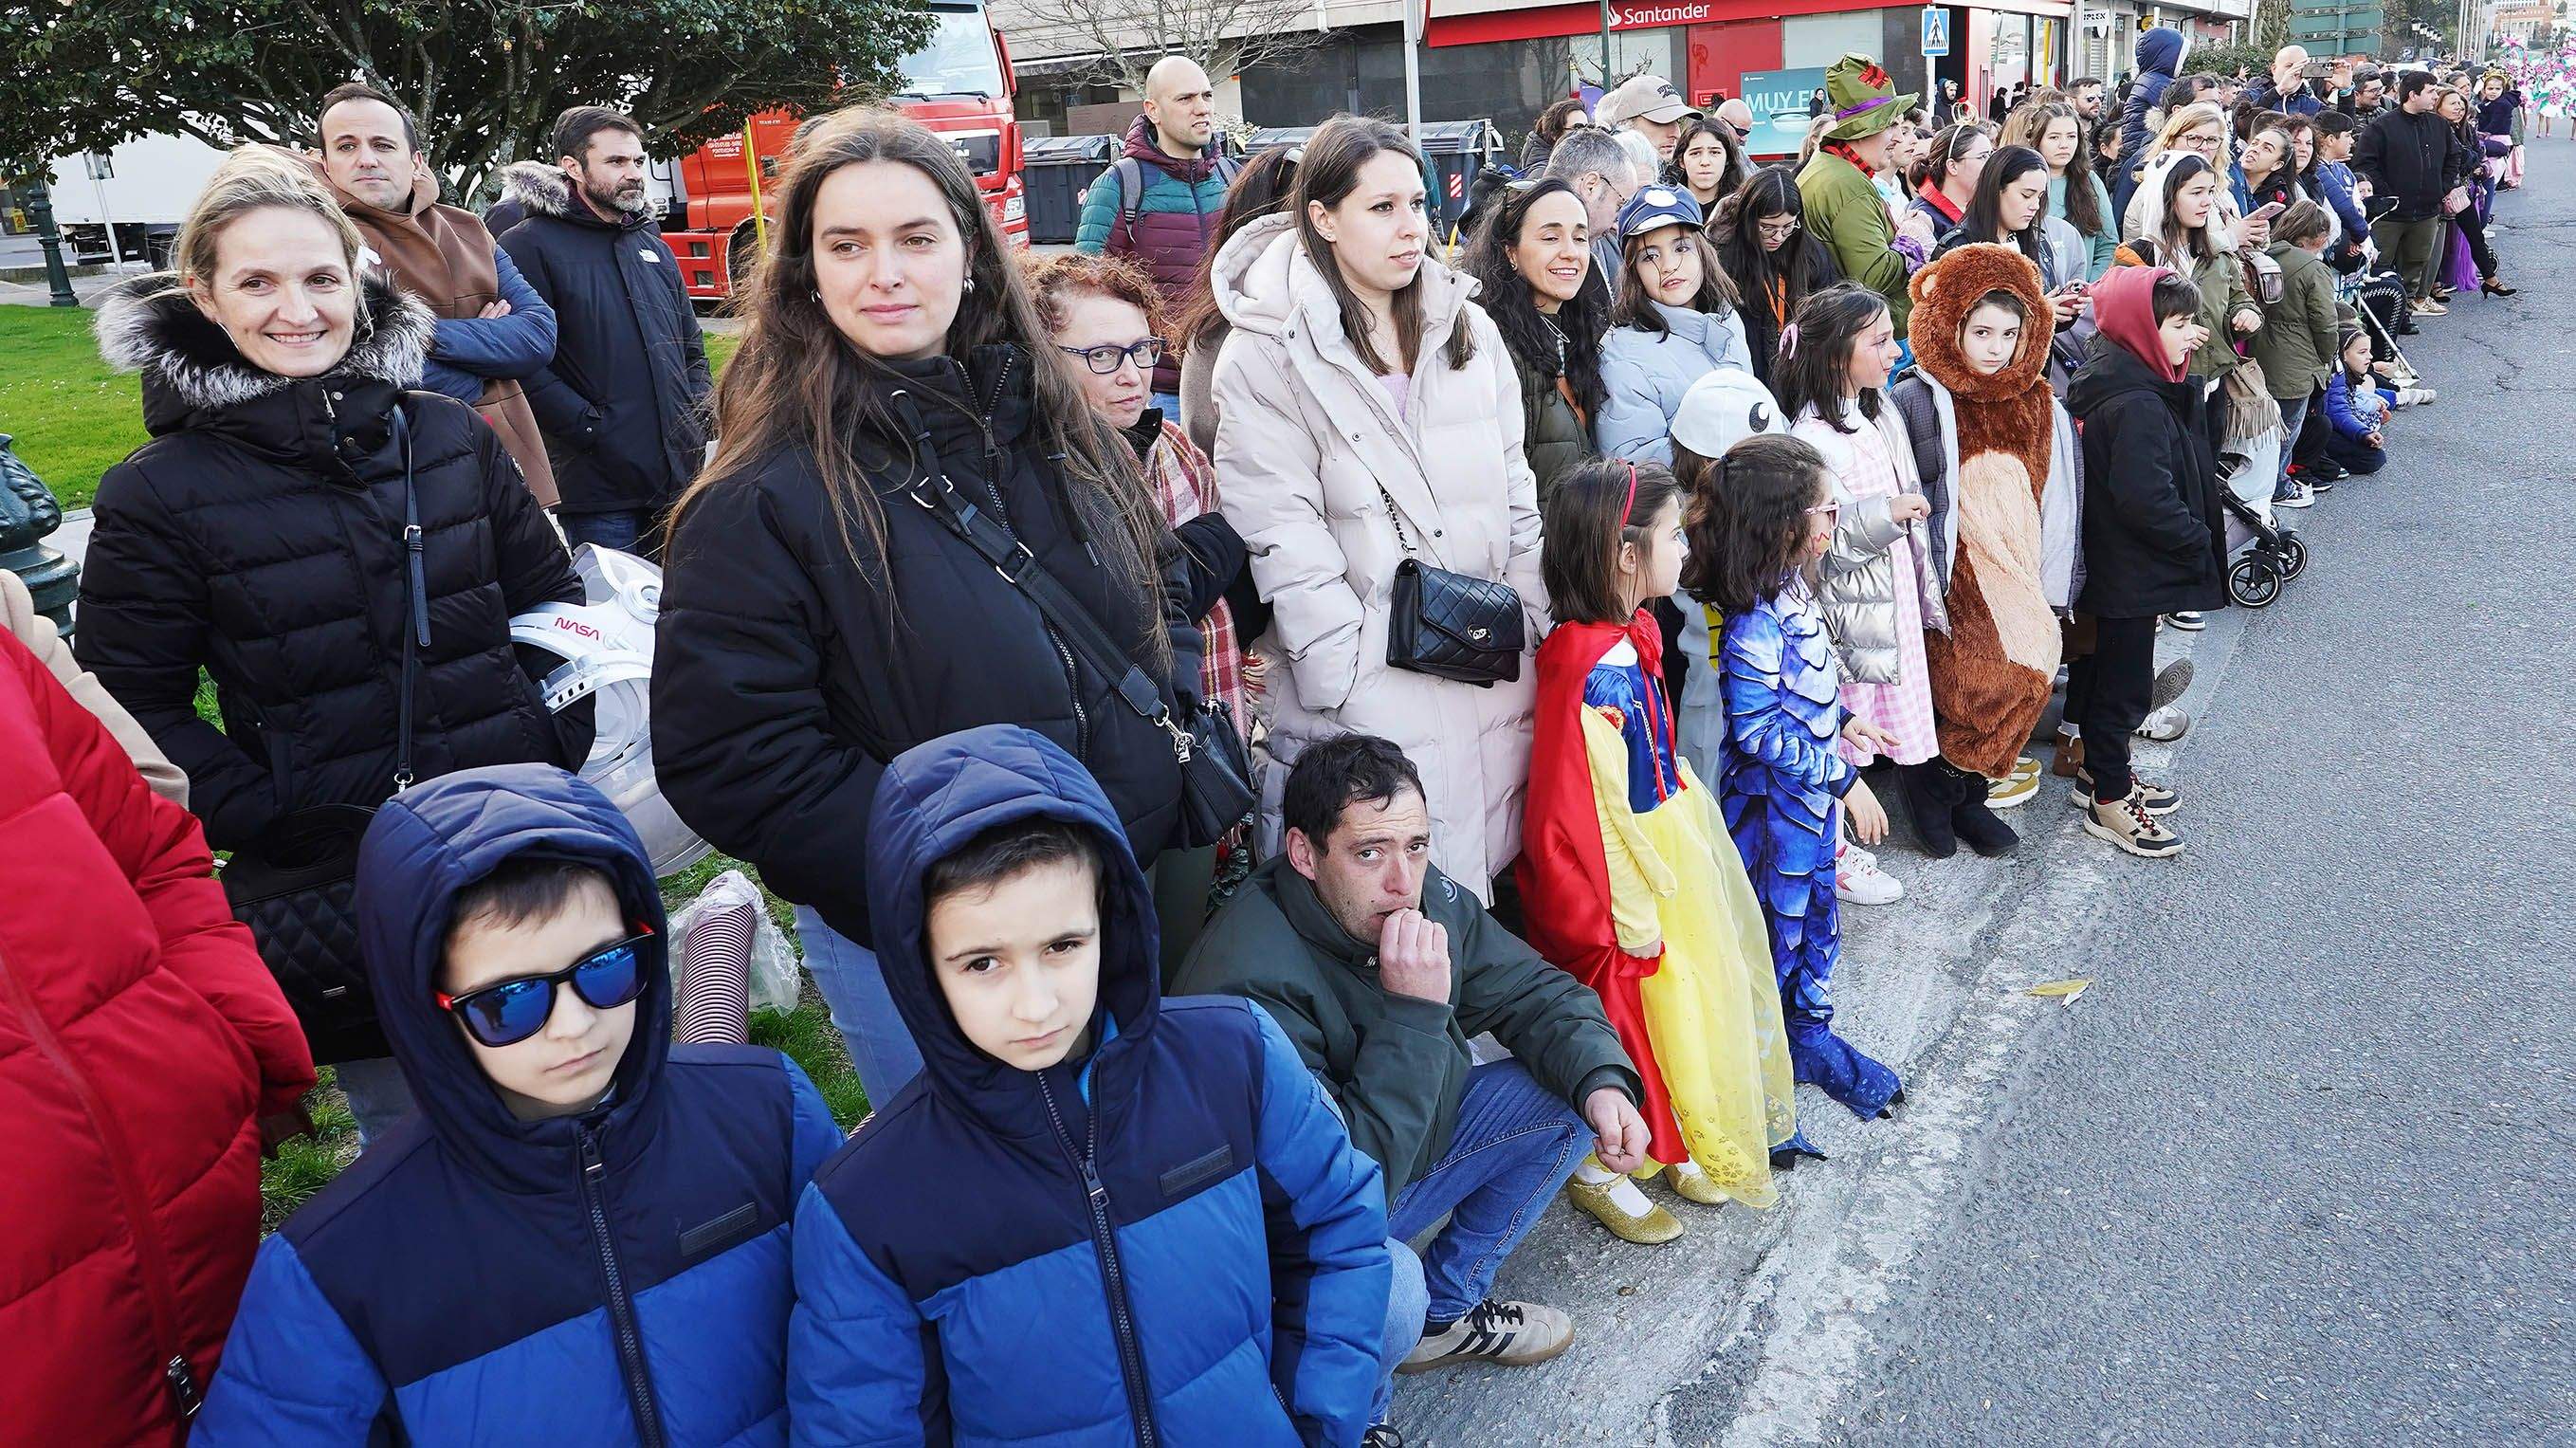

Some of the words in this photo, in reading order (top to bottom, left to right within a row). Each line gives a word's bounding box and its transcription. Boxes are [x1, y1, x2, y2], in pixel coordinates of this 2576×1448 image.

[1624, 3, 1710, 25] Santander
[1745, 91, 1793, 112] MUY
[555, 617, 599, 641] NASA
